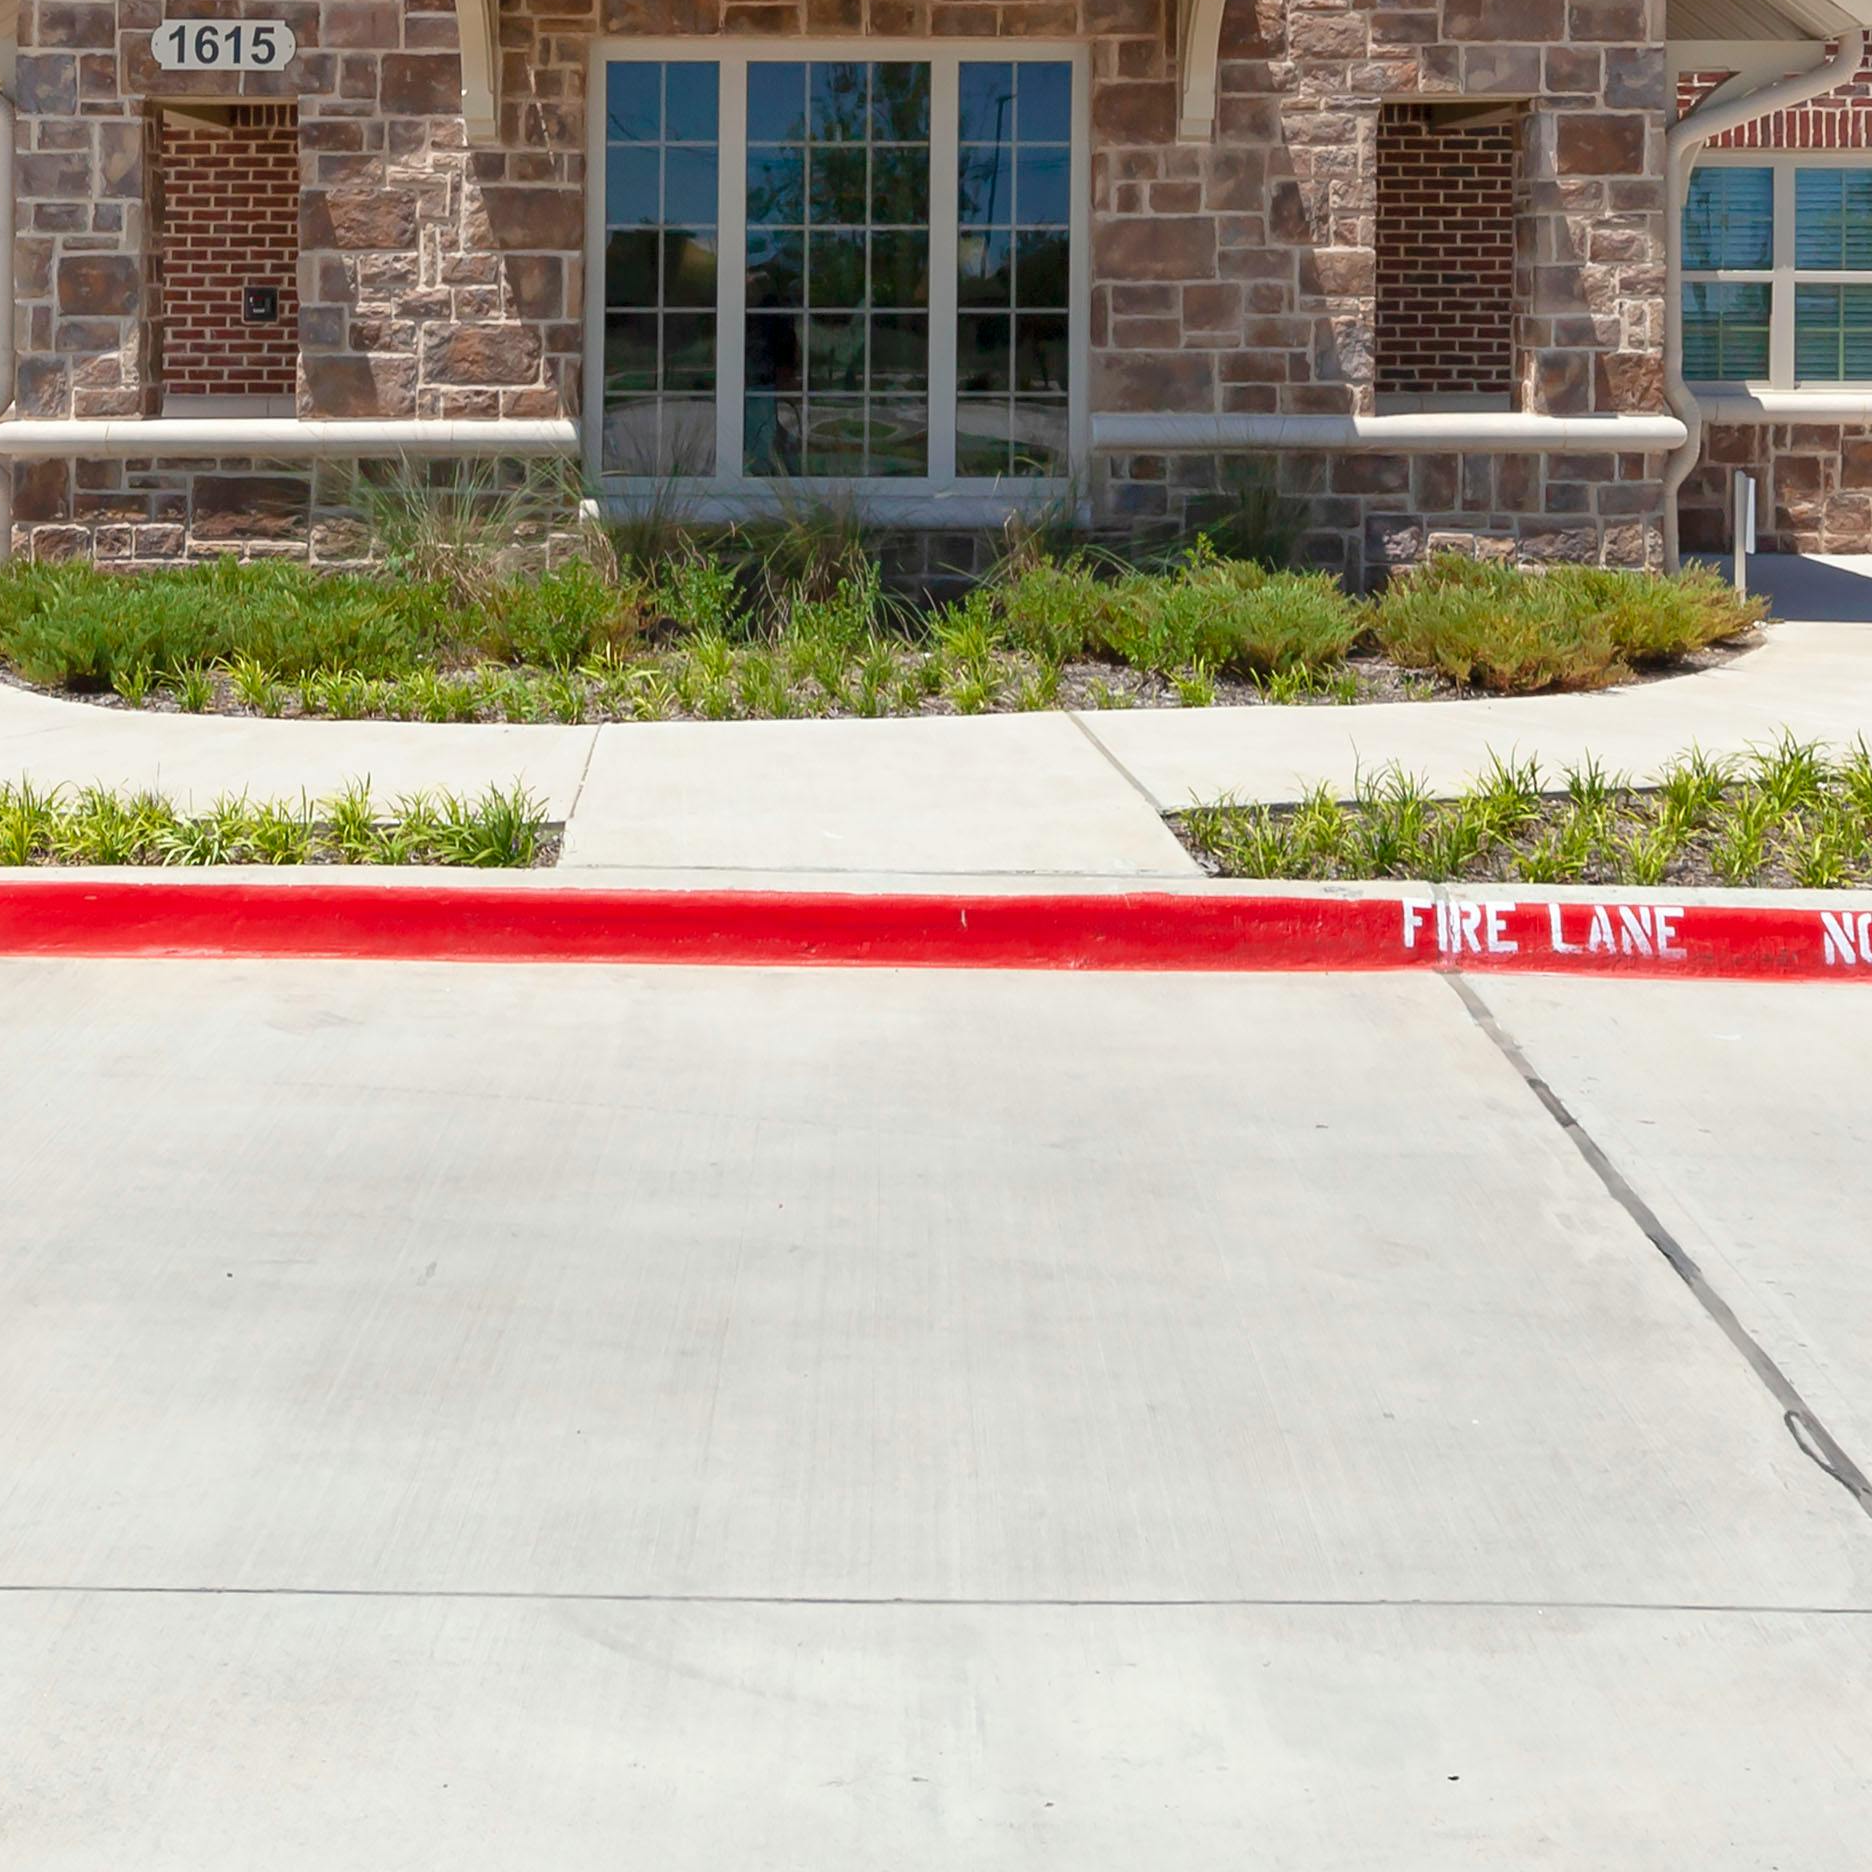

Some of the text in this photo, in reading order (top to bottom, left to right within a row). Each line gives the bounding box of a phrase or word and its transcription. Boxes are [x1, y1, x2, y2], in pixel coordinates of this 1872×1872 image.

[168, 24, 276, 65] 1615
[1401, 895, 1519, 955] FIRE
[1548, 902, 1688, 960] LANE
